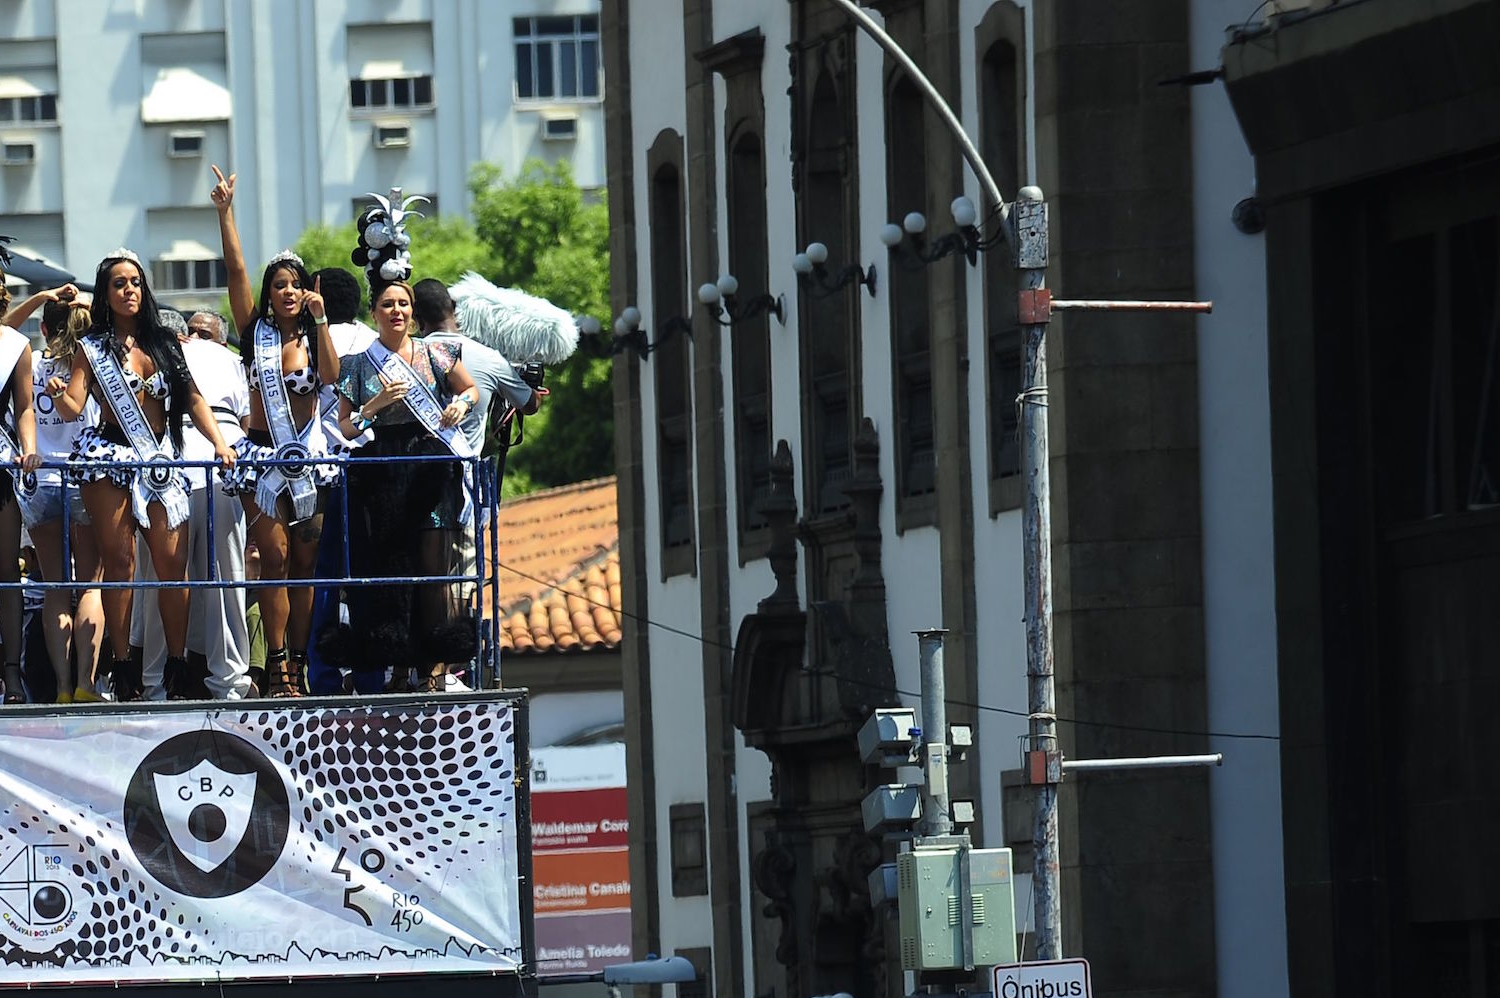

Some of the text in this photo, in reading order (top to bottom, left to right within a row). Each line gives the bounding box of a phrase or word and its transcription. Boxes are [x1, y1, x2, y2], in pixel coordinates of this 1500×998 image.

[264, 368, 279, 397] 2015
[97, 356, 142, 432] RAINHA 2015
[532, 821, 598, 836] Waldemar
[536, 882, 587, 898] Cristina
[392, 893, 420, 908] RIO
[390, 909, 424, 932] 450
[587, 943, 630, 958] Toledo
